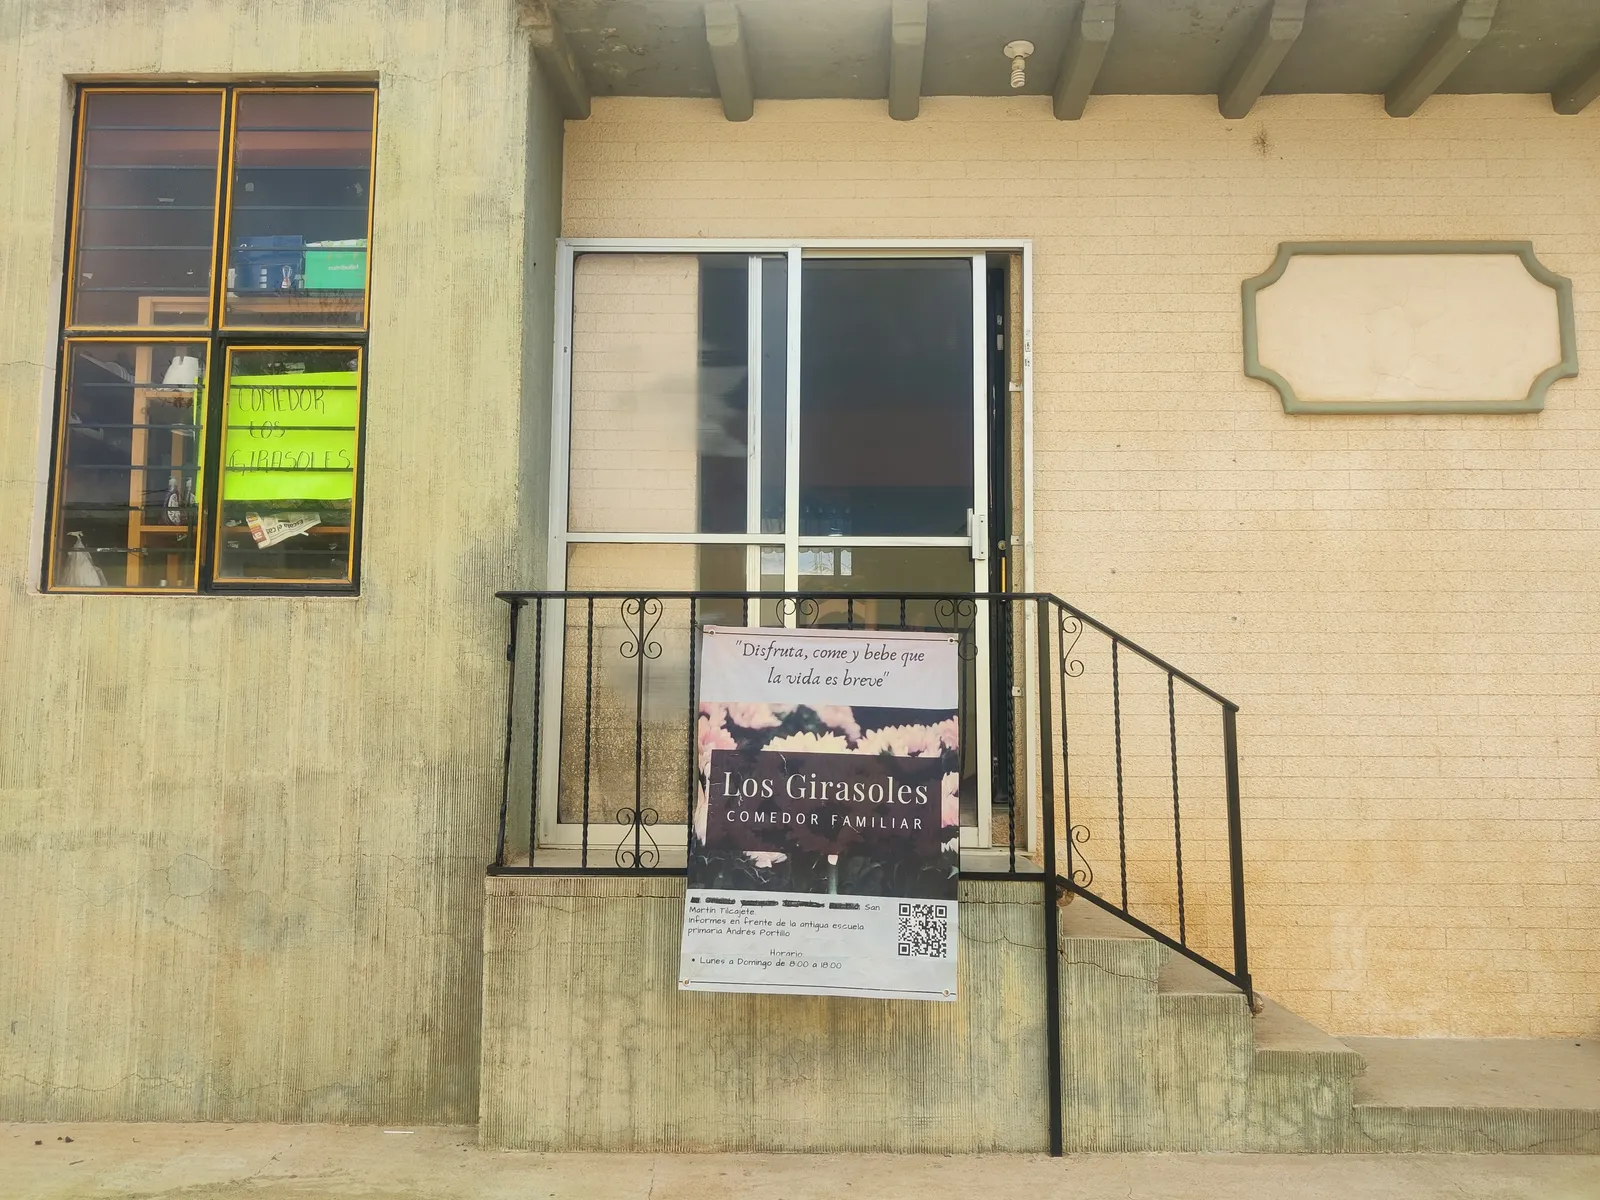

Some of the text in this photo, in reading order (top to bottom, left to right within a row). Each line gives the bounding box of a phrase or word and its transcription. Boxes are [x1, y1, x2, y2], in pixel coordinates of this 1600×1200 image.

[237, 386, 325, 415] COMEDOR
[249, 420, 286, 439] LOS
[228, 448, 351, 476] GIRASOLES
[735, 640, 925, 667] "Disfruta, come y bebe que
[767, 666, 890, 688] la vida es breve"
[722, 771, 929, 805] Los Girasoles
[726, 810, 922, 830] COMEDOR FAMILIAR
[864, 903, 881, 911] San
[688, 915, 727, 924] Informes
[744, 917, 773, 927] frente
[776, 918, 786, 927] de
[799, 920, 829, 932] antigua
[832, 922, 864, 931] escuela
[688, 927, 723, 936] primaria
[760, 928, 790, 937] Portillo
[700, 956, 726, 965] Lunes
[737, 957, 773, 970] Domingo
[775, 958, 786, 967] de
